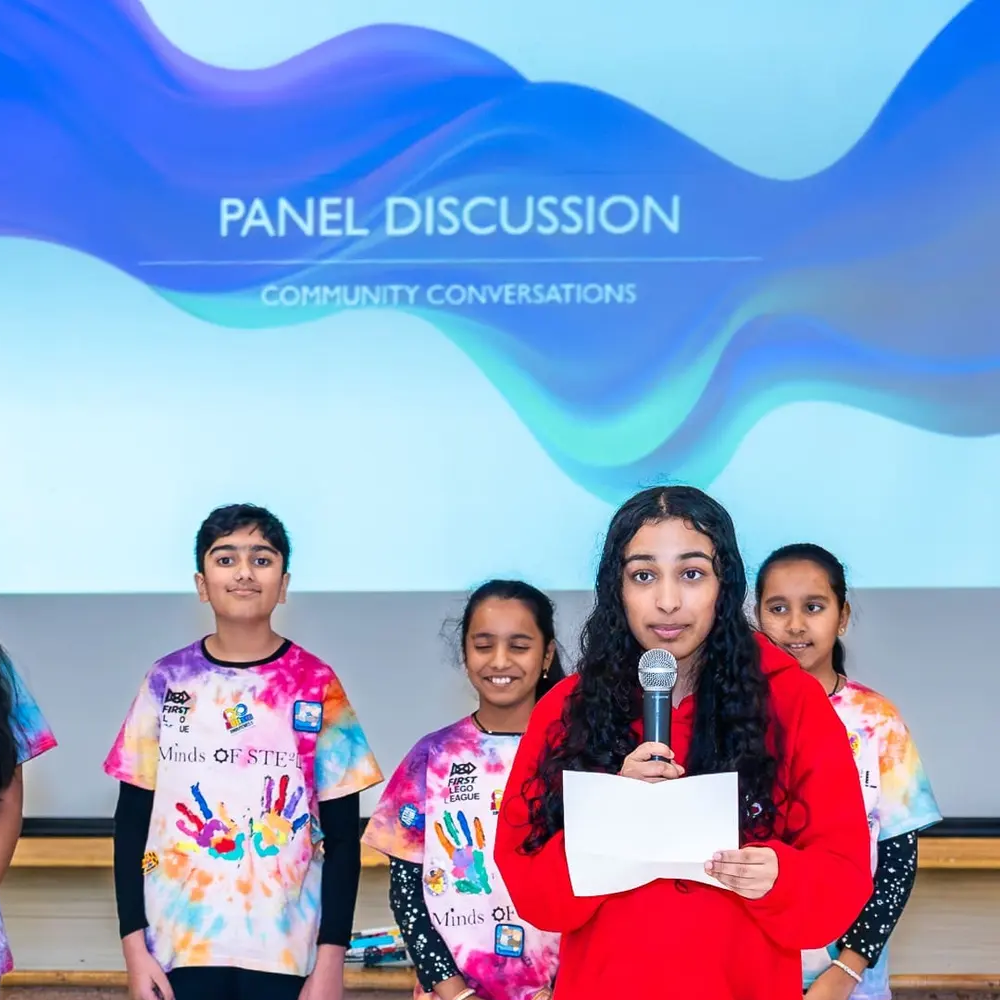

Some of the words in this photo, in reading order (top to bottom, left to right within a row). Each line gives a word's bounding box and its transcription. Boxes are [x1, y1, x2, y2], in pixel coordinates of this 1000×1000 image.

[219, 197, 369, 237] PANEL
[385, 195, 680, 236] DISCUSSION
[261, 284, 419, 307] COMMUNITY
[427, 283, 637, 306] CONVERSATIONS
[162, 705, 191, 714] FIRST
[158, 743, 206, 763] Minds
[213, 748, 242, 764] OF
[448, 776, 478, 787] FIRST
[448, 785, 474, 794] LEGO
[443, 793, 480, 804] LEAGUE
[432, 907, 486, 926] Minds
